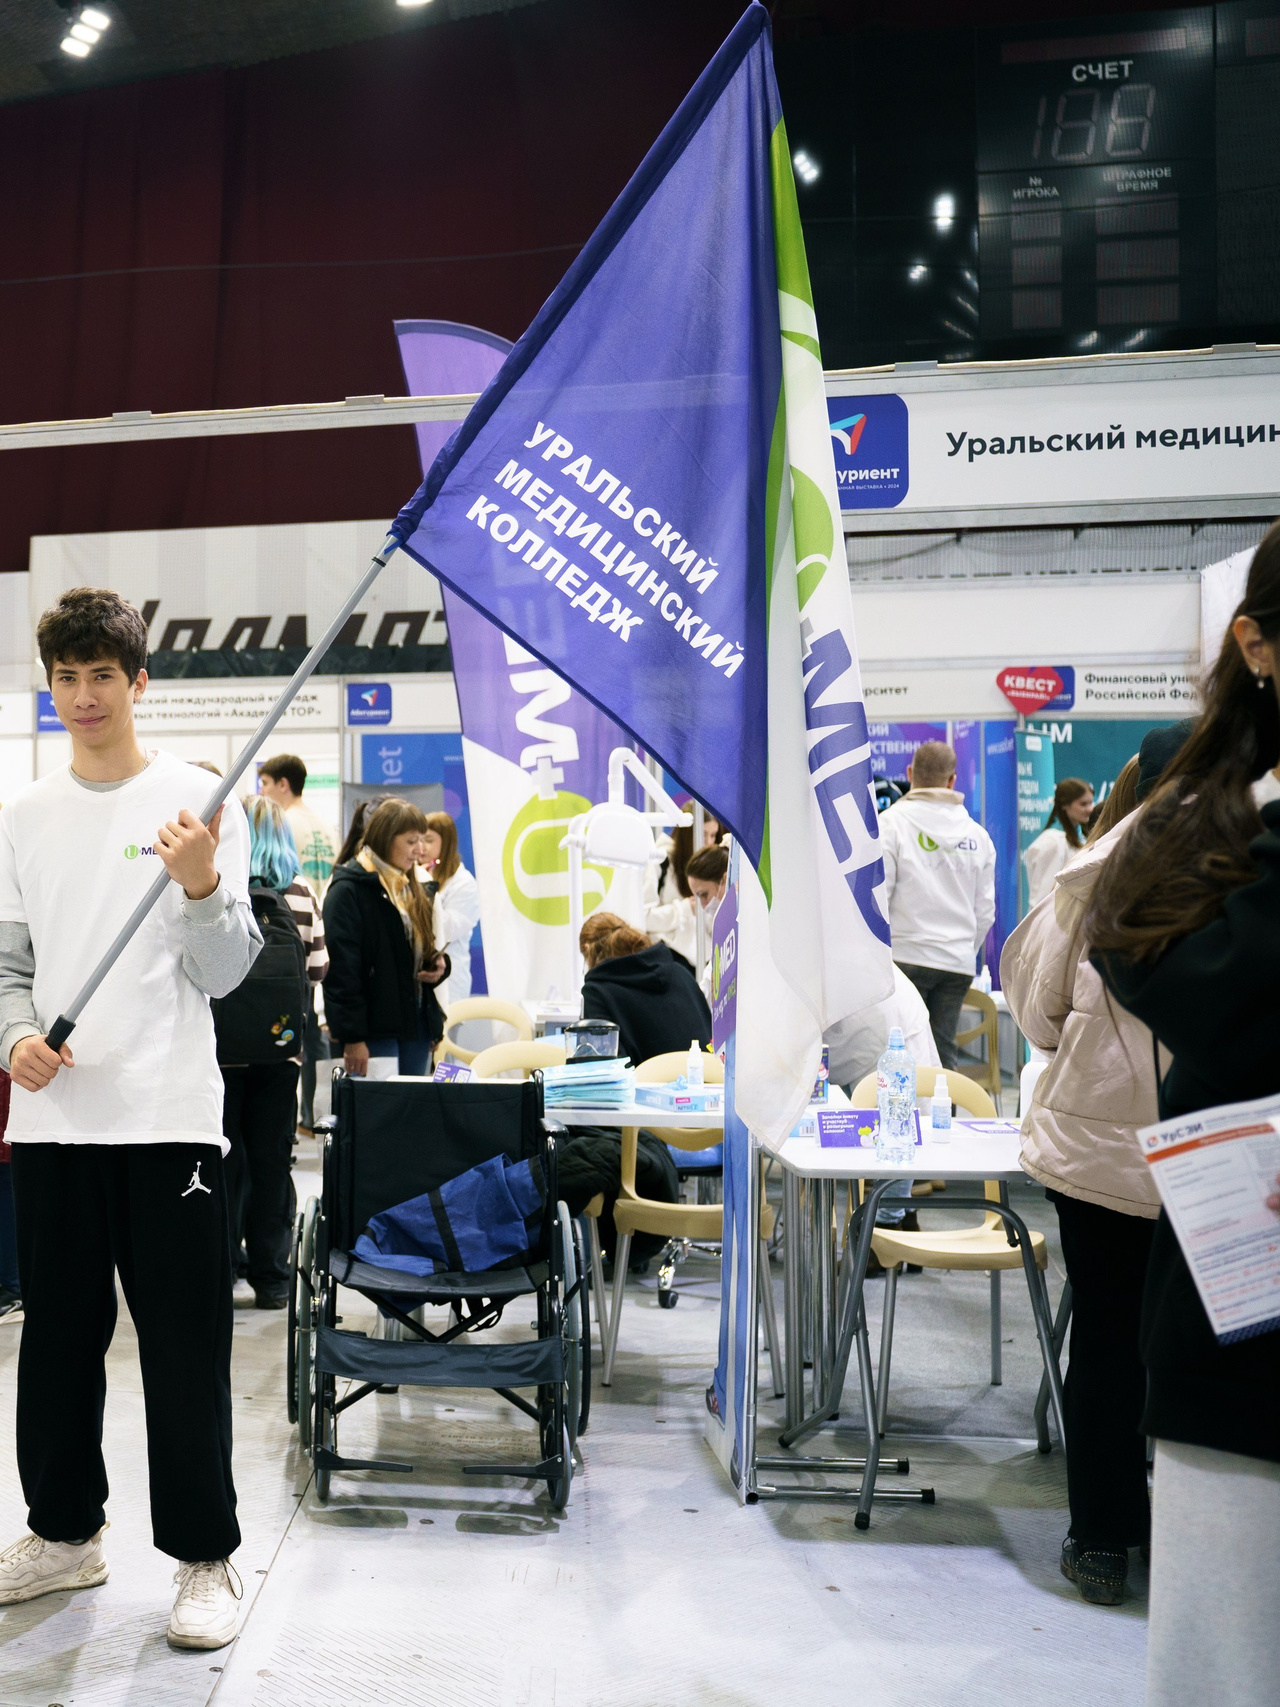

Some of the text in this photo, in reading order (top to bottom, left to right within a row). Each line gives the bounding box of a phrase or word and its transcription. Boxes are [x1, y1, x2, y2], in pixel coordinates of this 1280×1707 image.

[1071, 60, 1134, 83] СЧЕТ
[1102, 166, 1172, 182] ШТРАФНОЕ
[1012, 186, 1060, 200] ИГРОКА
[1116, 180, 1158, 192] ВРЕМЯ
[946, 424, 1125, 463] Уральский
[835, 467, 900, 484] уриент
[524, 420, 719, 595] УРАЛЬСКИЙ
[465, 495, 644, 643] КОЛЛЕДЖ
[494, 459, 746, 679] МЕДИЦИНСКИЙ
[1004, 675, 1057, 693] КВЕСТ
[1084, 673, 1167, 684] Финансовый
[171, 693, 266, 705] международный
[1085, 688, 1166, 701] Российской
